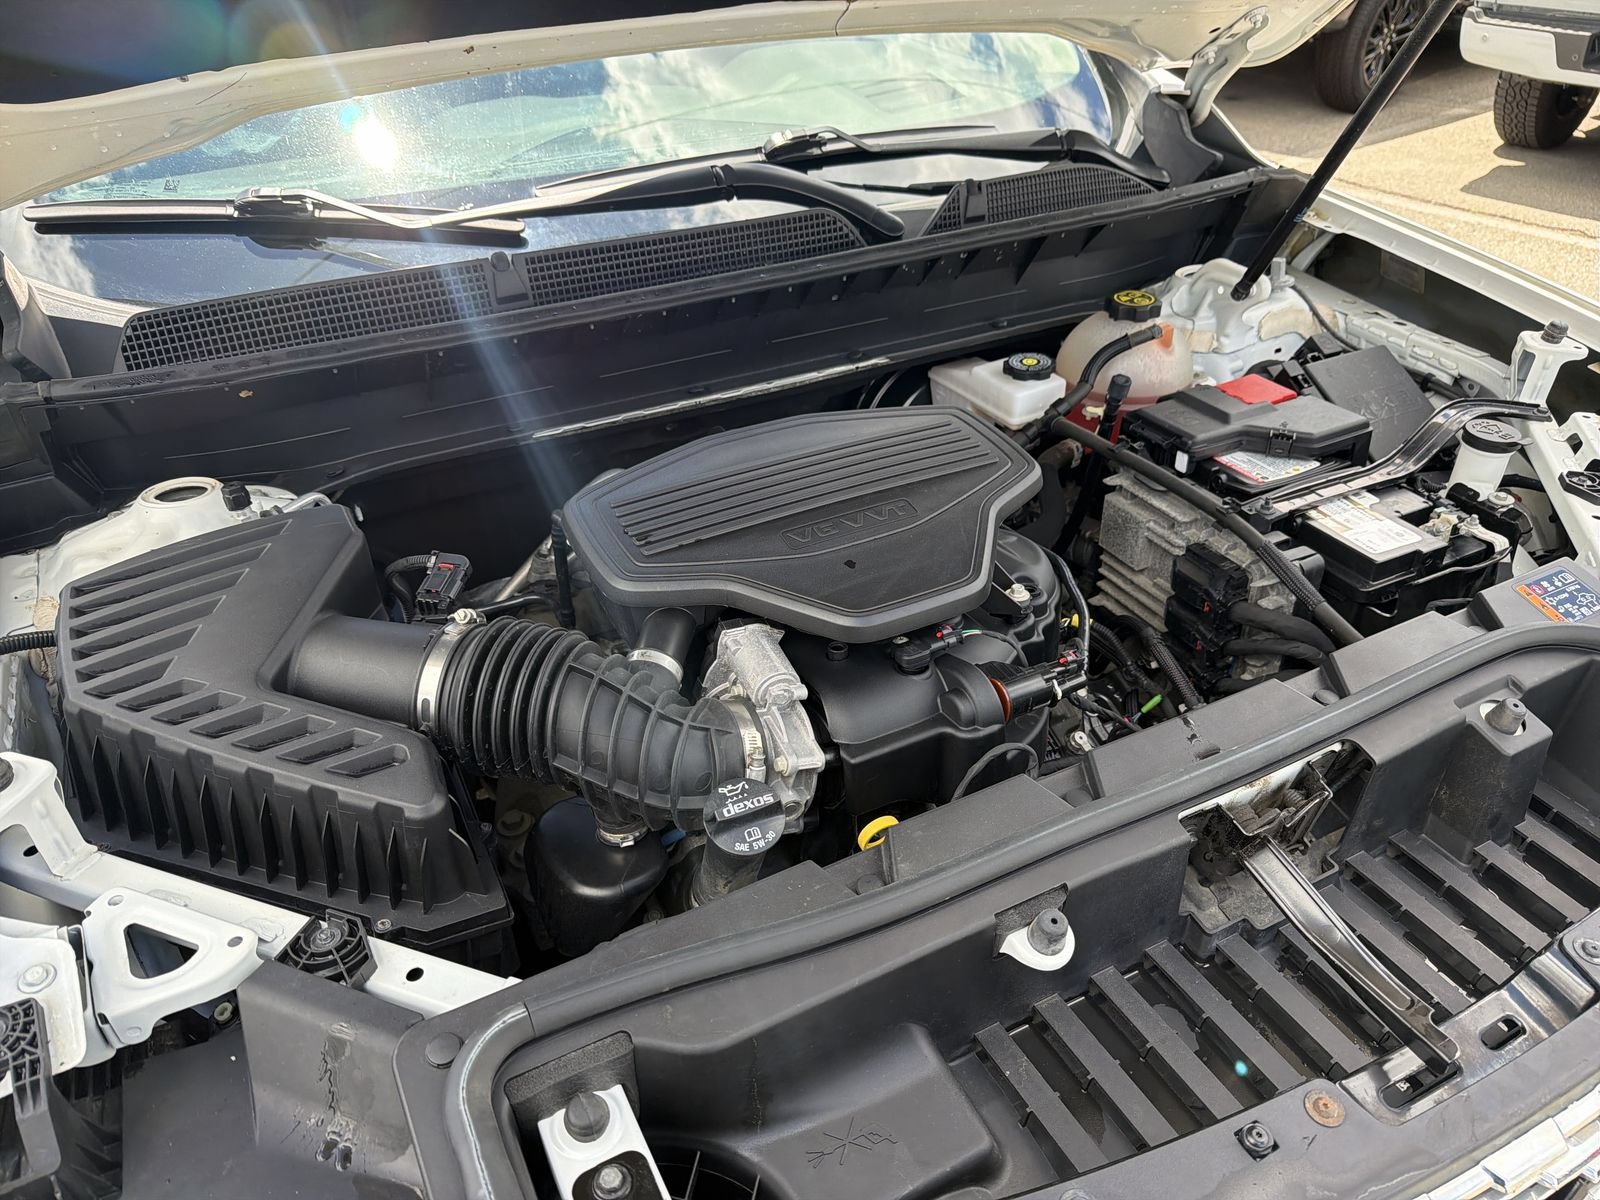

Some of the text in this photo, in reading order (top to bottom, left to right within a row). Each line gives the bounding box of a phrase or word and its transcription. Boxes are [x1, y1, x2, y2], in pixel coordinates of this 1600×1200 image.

[786, 503, 906, 542] V6 VVT
[722, 793, 774, 817] dexos
[734, 830, 776, 852] SAE 5W-30
